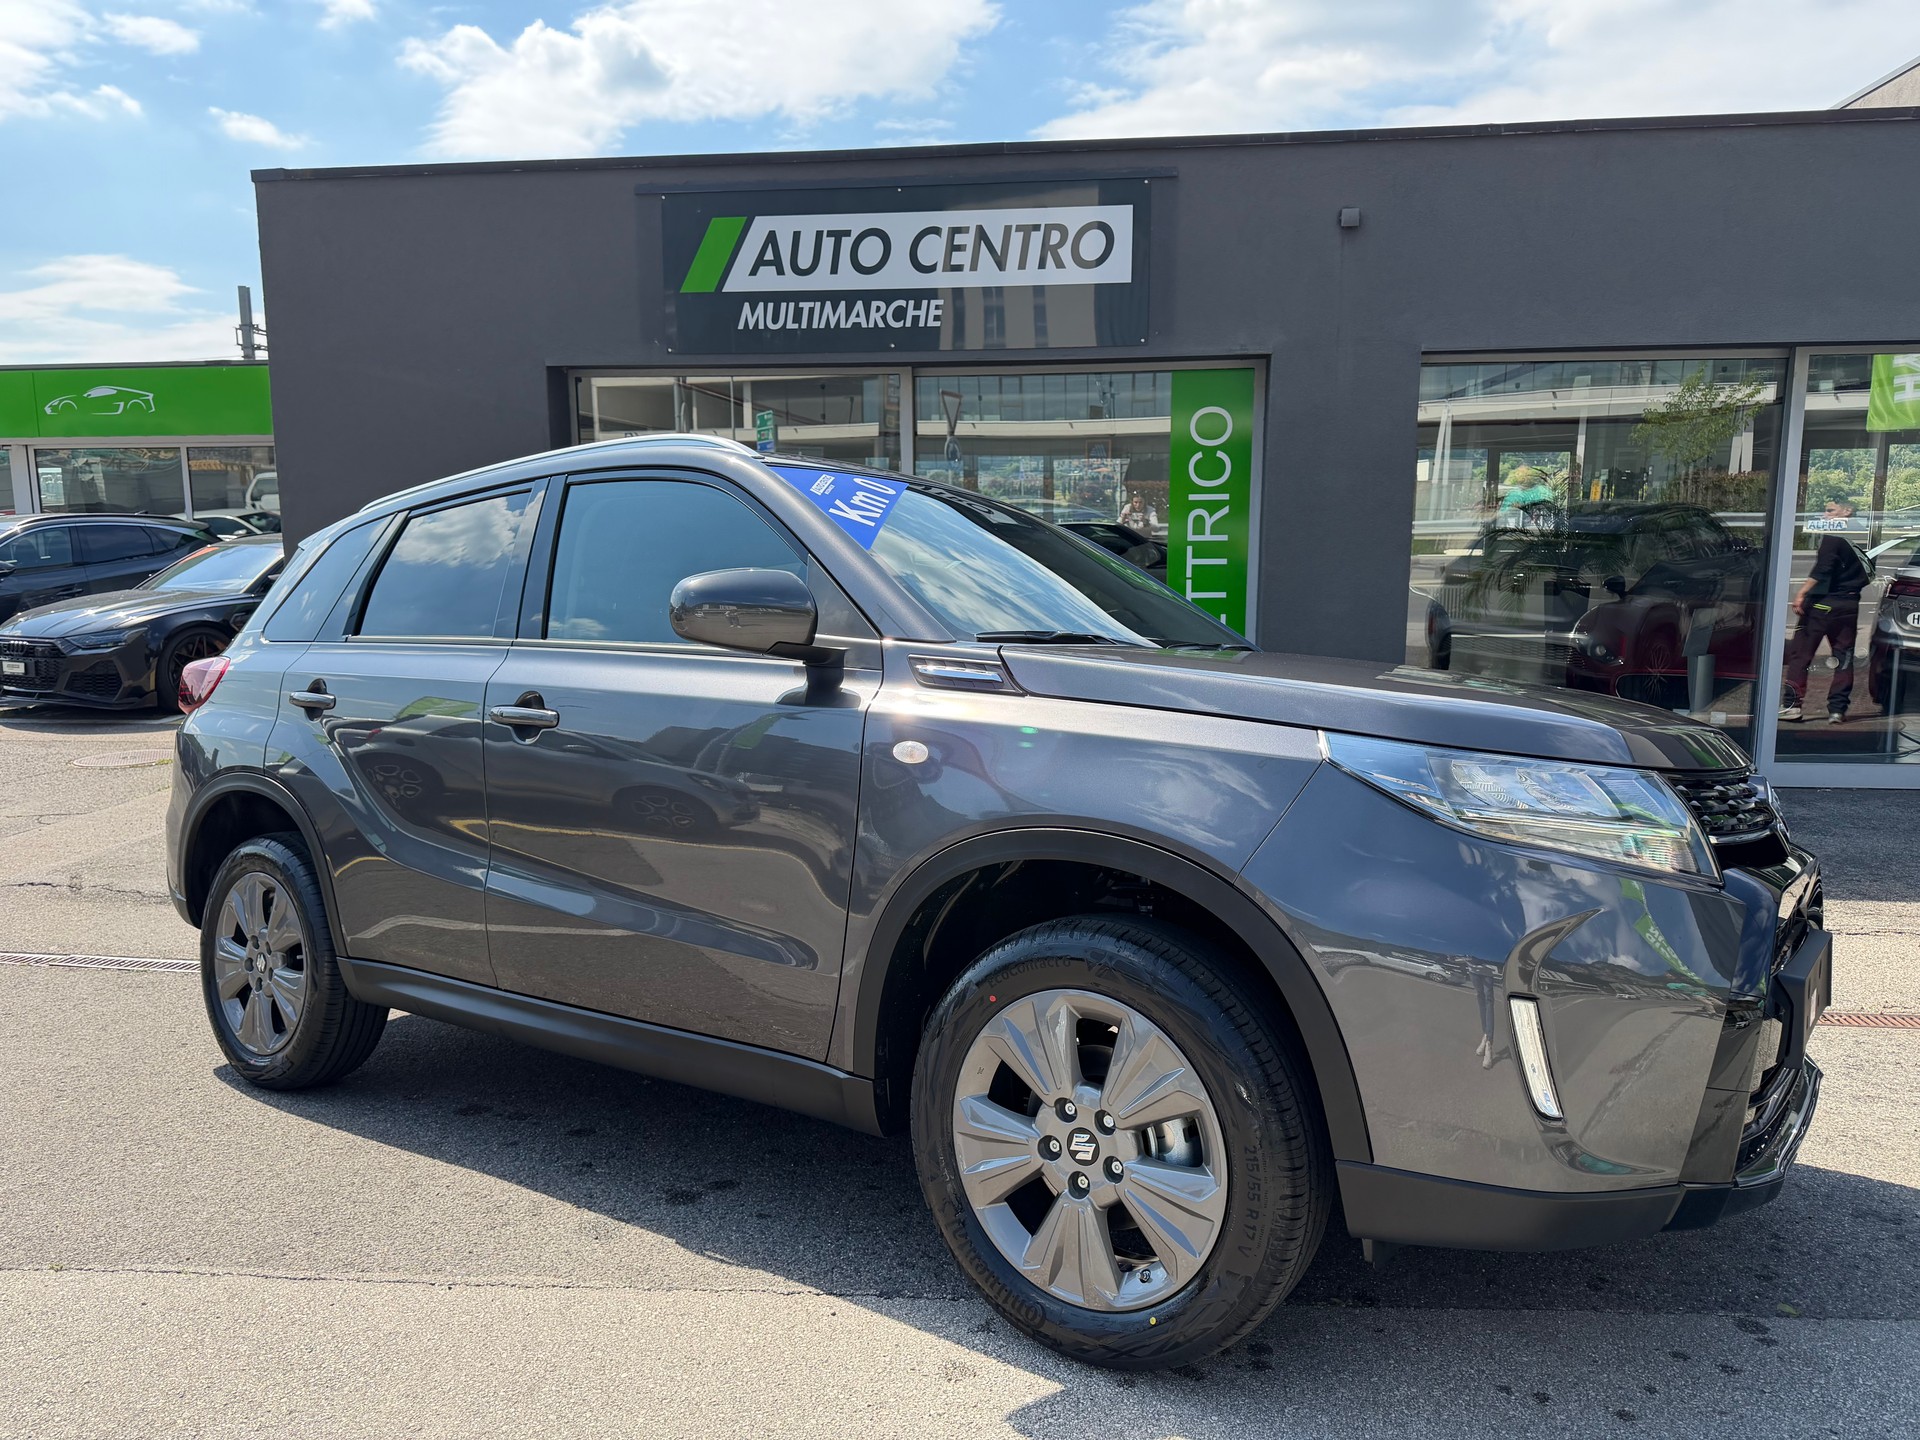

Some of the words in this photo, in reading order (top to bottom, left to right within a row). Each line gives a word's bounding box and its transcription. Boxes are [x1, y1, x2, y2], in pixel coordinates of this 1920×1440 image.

[748, 229, 892, 277] AUTO
[909, 221, 1115, 274] CENTRO
[737, 299, 944, 331] MULTIMARCHE
[828, 491, 890, 527] Km
[853, 478, 896, 495] 0
[1185, 405, 1233, 625] TTRICO
[1244, 1145, 1262, 1202] 215/55
